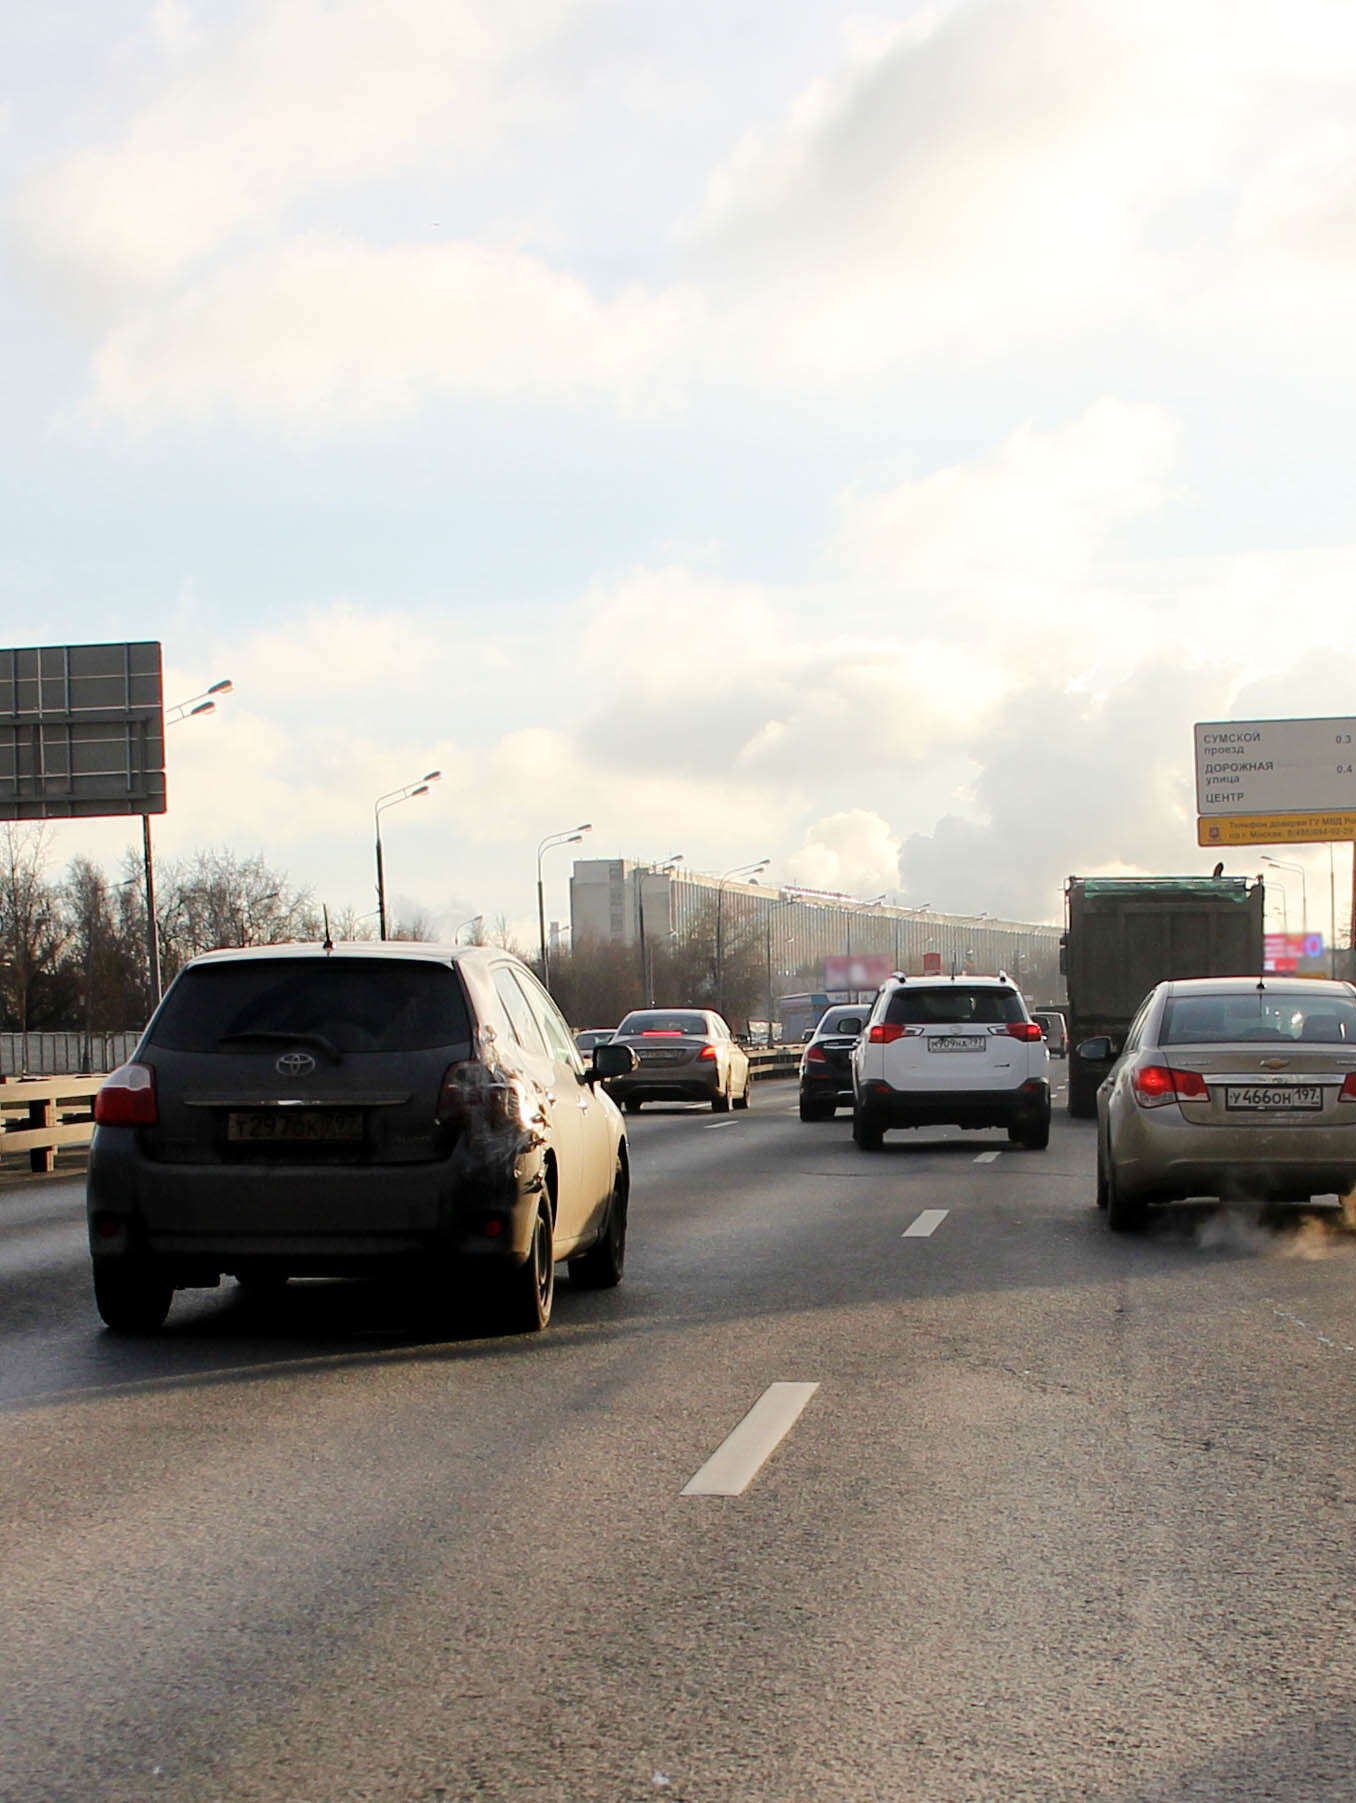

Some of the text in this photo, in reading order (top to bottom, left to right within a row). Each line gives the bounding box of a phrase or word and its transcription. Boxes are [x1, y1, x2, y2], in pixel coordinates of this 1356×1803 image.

[1203, 731, 1352, 744] СУМСКОЙ 0.3
[1204, 746, 1245, 757] проезд
[1205, 761, 1353, 775] ДОРОЖНАЯ 0.4
[1206, 776, 1240, 786] улица
[1206, 792, 1245, 803] ЦЕНТР
[1231, 1087, 1318, 1105] У466ОН 197
